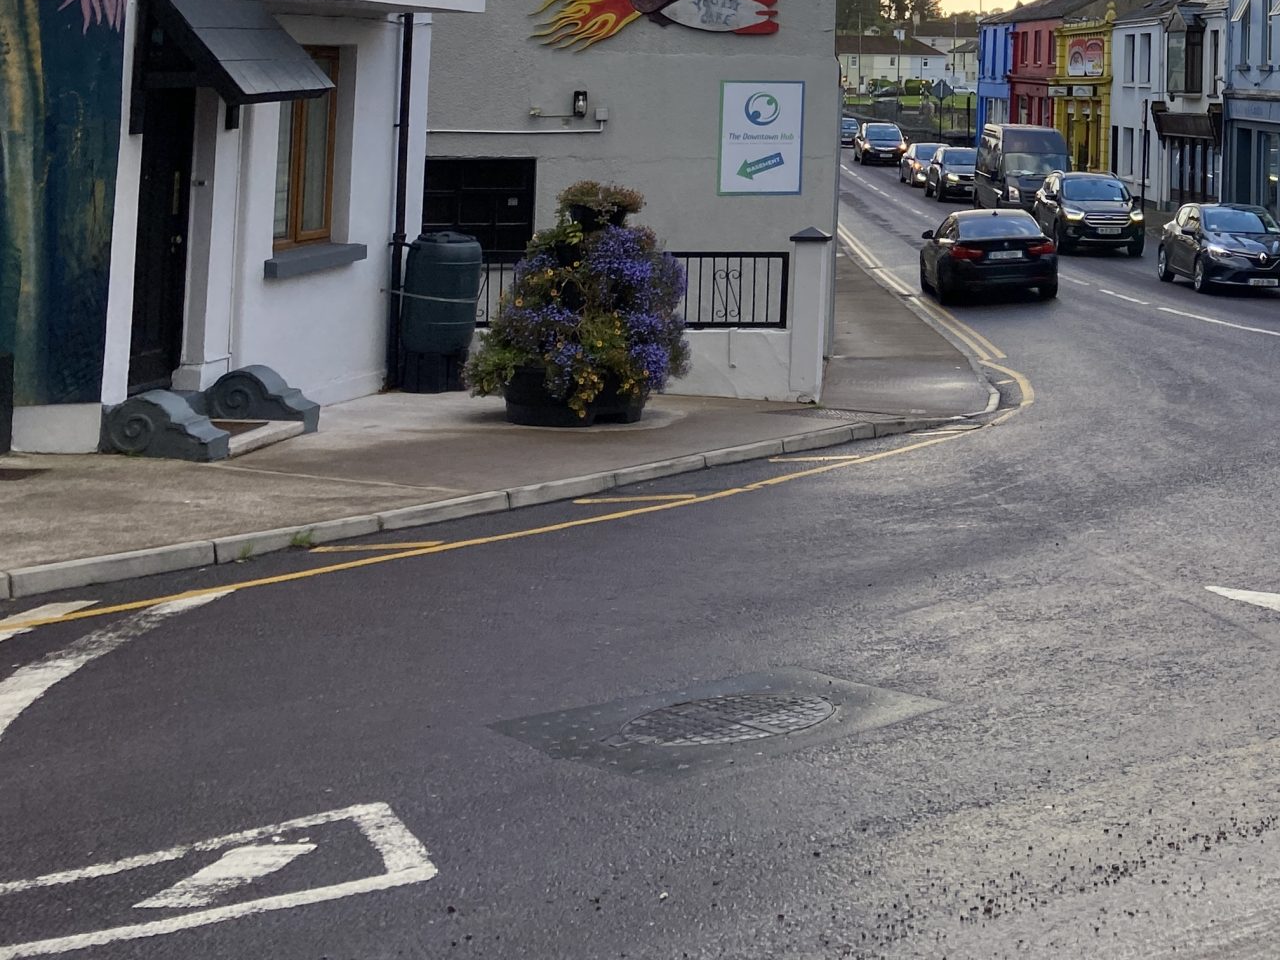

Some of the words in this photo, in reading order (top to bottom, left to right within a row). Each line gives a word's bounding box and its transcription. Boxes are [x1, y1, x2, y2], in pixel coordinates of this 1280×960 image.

[701, 13, 736, 26] CAFE
[728, 132, 741, 141] The
[742, 132, 779, 141] Downtown
[780, 132, 795, 141] Hub
[746, 156, 781, 173] BASEMENT
